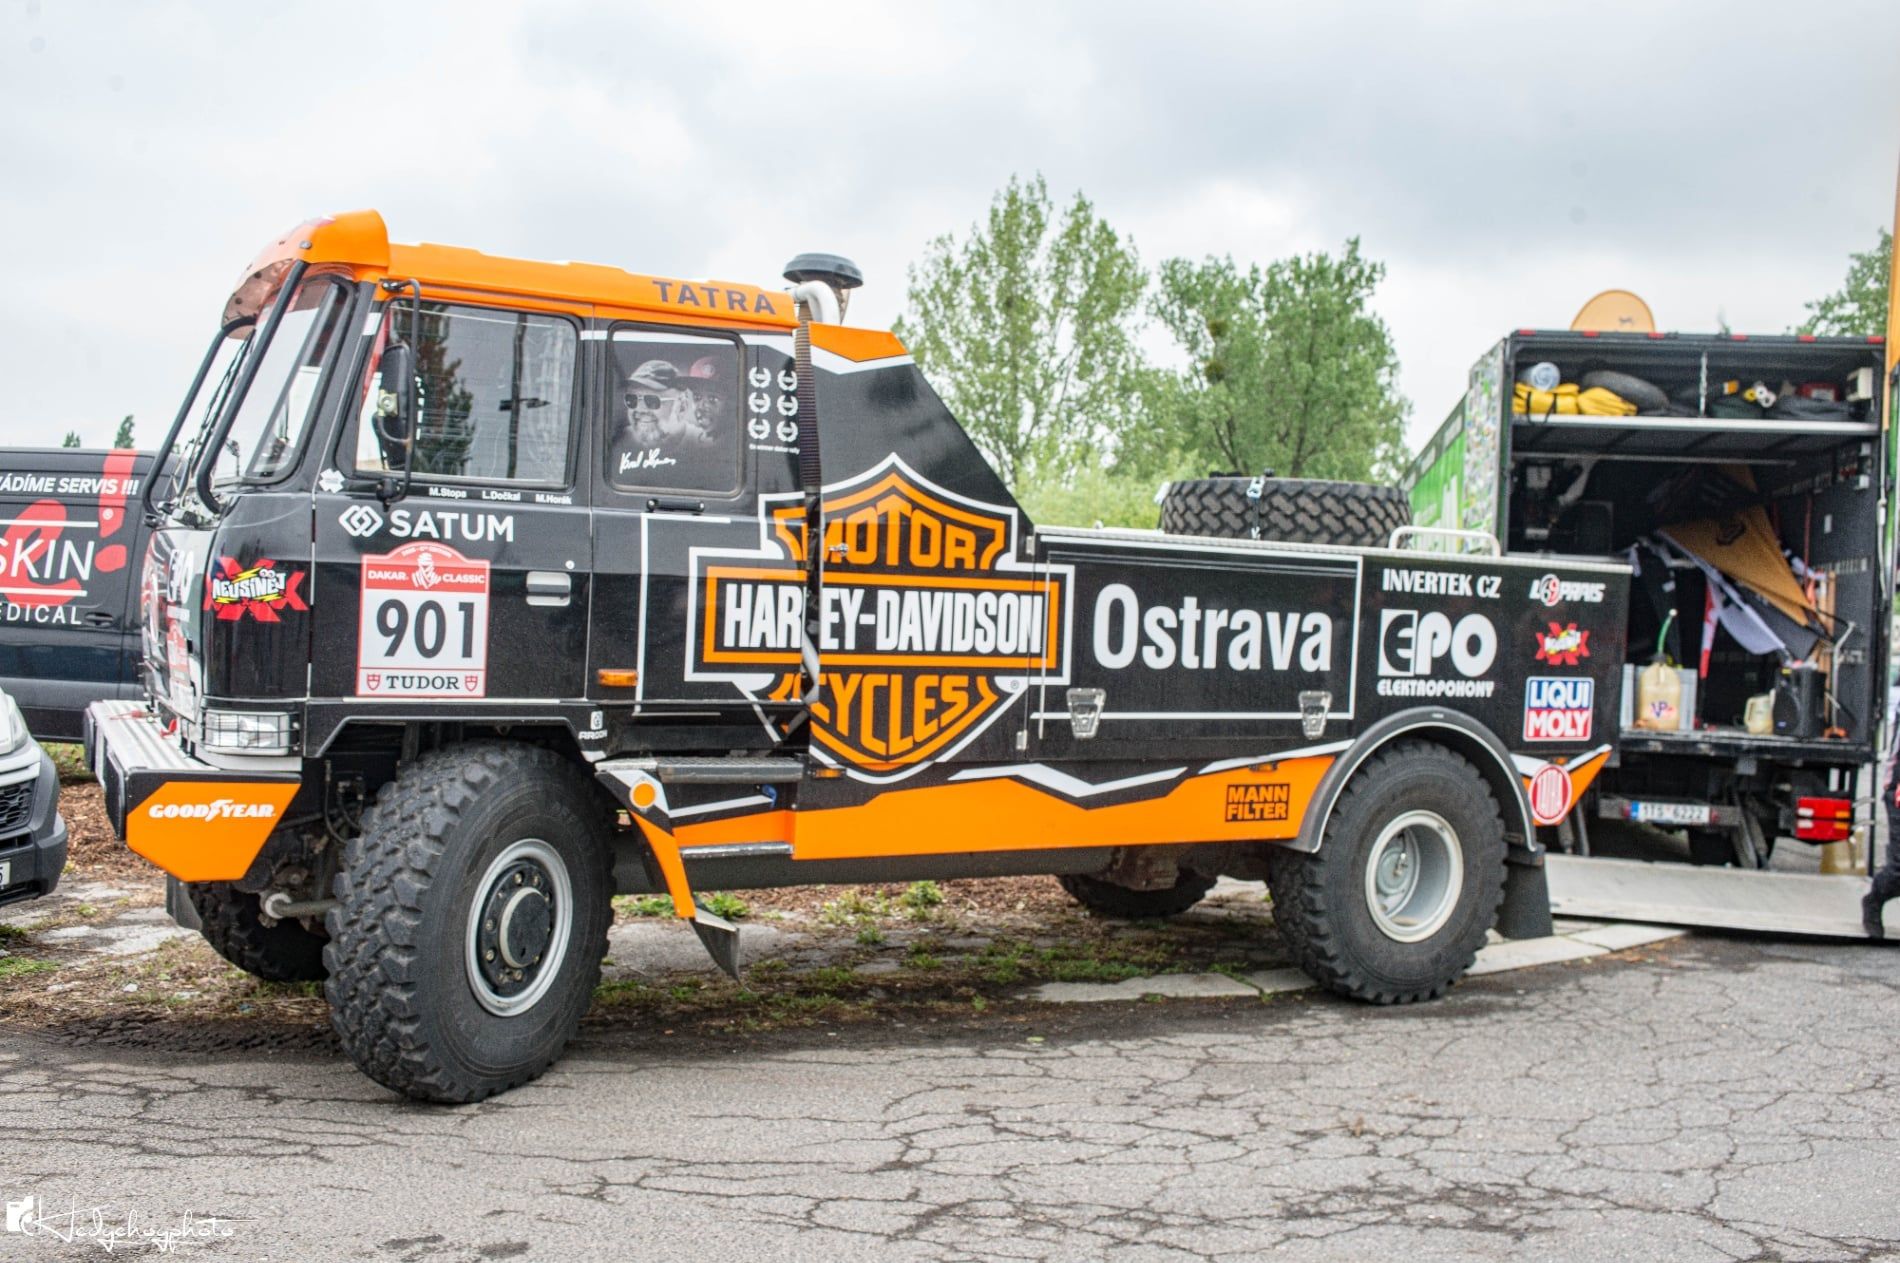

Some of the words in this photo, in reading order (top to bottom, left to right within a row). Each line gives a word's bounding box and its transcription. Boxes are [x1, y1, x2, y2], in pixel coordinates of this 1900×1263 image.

[652, 279, 776, 315] TATRA
[57, 477, 118, 495] SERVIS
[389, 510, 514, 542] SATUM
[367, 570, 408, 581] DAKAR
[442, 573, 485, 585] CLASSIC
[1382, 568, 1473, 597] INVERTEK
[1476, 575, 1502, 599] CZ
[0, 602, 82, 625] DICAL
[723, 583, 1044, 655] HAREY-DAVIDSON
[376, 598, 475, 659] 901
[1093, 583, 1333, 672] Ostrava
[1377, 608, 1498, 678] EPO
[386, 675, 460, 690] TUDOR
[1376, 679, 1495, 698] ELEKTROPOHONY
[1530, 681, 1590, 708] LIQUI
[1528, 710, 1590, 738] MOLY
[1228, 785, 1288, 803] MANN
[149, 800, 274, 821] GOODYEAR
[1226, 802, 1287, 821] FILTER
